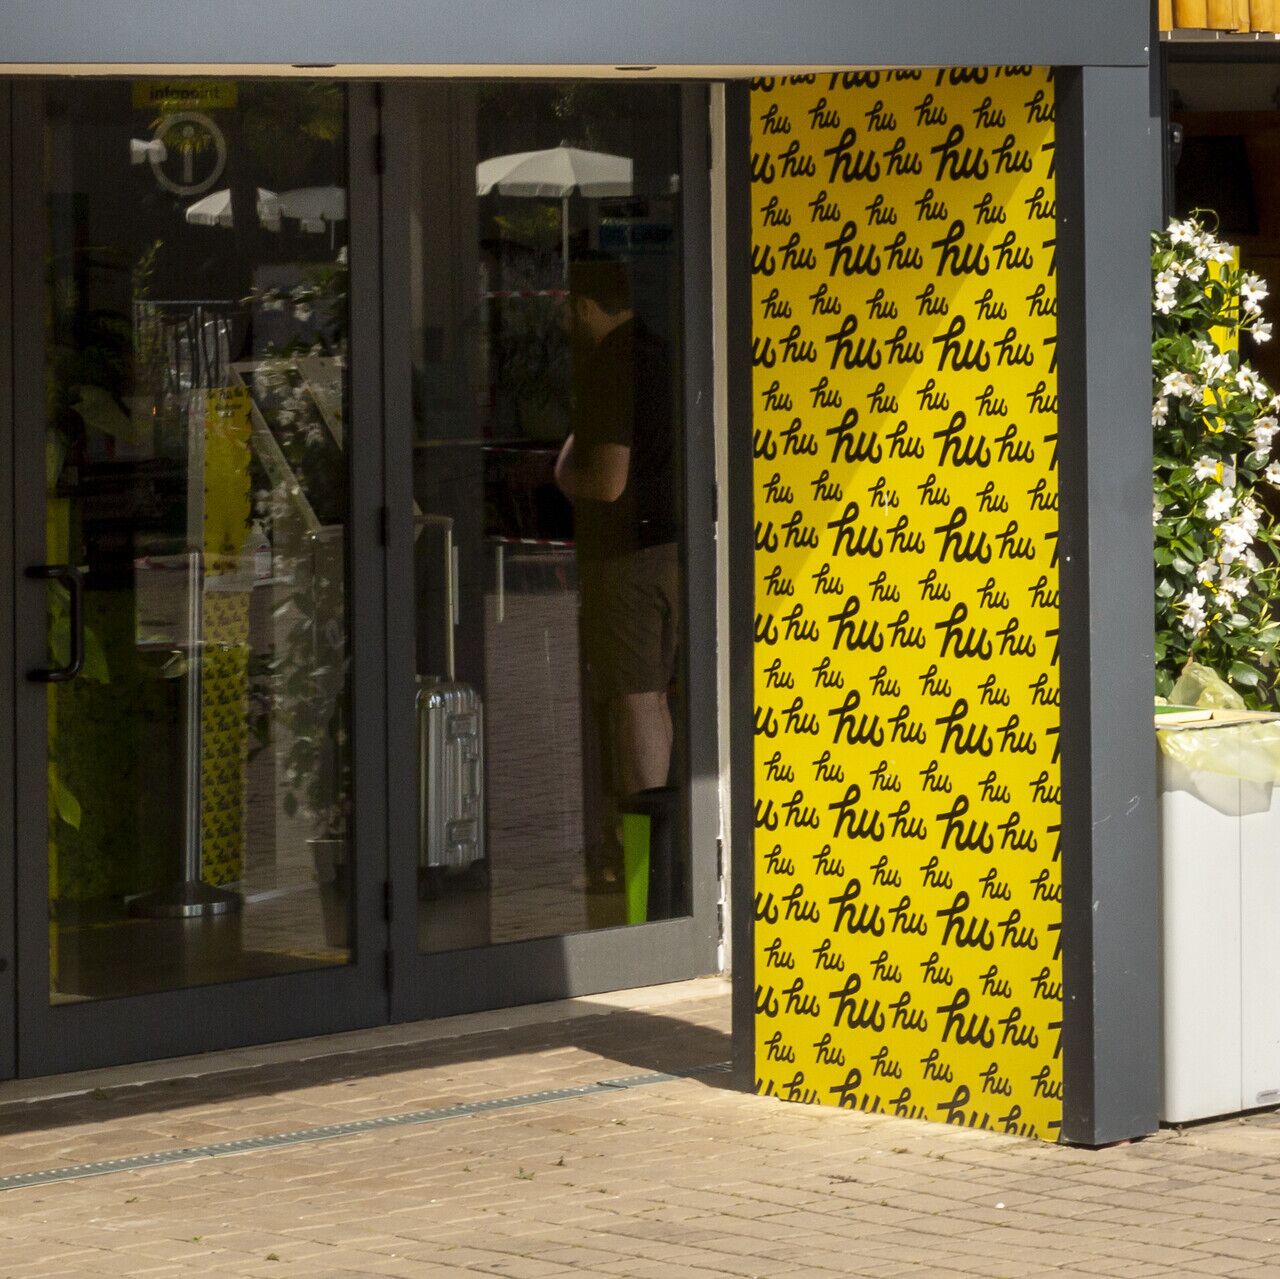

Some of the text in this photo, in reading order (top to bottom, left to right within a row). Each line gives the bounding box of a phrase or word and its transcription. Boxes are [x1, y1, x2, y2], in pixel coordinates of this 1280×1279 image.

[761, 104, 791, 134] hu
[809, 97, 840, 129] hu
[865, 101, 896, 131] hu
[915, 94, 947, 126] hu
[973, 97, 1005, 128] hu
[778, 124, 1032, 183] hu hu hu hu hu
[761, 196, 791, 226] hu
[809, 191, 840, 221] hu
[866, 194, 897, 225] hu
[915, 189, 947, 220] hu
[974, 193, 1006, 224] hu
[779, 220, 1033, 276] hu hu hu hu hu
[762, 288, 791, 318] hu
[809, 283, 841, 314] hu
[866, 288, 897, 319] hu
[916, 283, 948, 315] hu
[975, 289, 1006, 320] hu
[779, 314, 1033, 371] hu hu hu hu hu
[762, 381, 792, 411] hu
[810, 377, 841, 408] hu
[867, 383, 898, 413] hu
[917, 379, 949, 410] hu
[976, 385, 1007, 416] hu
[780, 408, 1034, 467] hu hu hu hu hu
[763, 473, 793, 503] hu
[811, 470, 842, 501] hu
[868, 477, 899, 508] hu
[918, 474, 949, 506] hu
[976, 481, 1008, 512] hu
[781, 502, 1035, 564] hu hu hu hu hu
[764, 565, 794, 596] hu
[812, 563, 843, 595] hu
[869, 571, 899, 602] hu
[919, 569, 950, 601] hu
[977, 578, 1009, 609] hu
[782, 596, 1035, 660] hu hu hu hu hu
[764, 659, 794, 689] hu
[813, 657, 843, 689] hu
[870, 666, 900, 697] hu
[919, 665, 951, 697] hu
[978, 674, 1009, 706] hu
[782, 690, 1036, 757] hu hu hu hu hu
[764, 752, 794, 782] hu
[813, 751, 844, 782] hu
[870, 761, 900, 792] hu
[920, 760, 951, 793] hu
[979, 771, 1010, 803] hu
[782, 784, 1037, 854] hu hu hu hu hu
[764, 845, 794, 875] hu
[813, 845, 844, 877] hu
[870, 855, 901, 887] hu
[920, 856, 952, 889] hu
[979, 868, 1011, 900] hu
[782, 879, 1037, 951] hu hu hu hu hu
[764, 938, 794, 969] hu
[813, 939, 844, 971] hu
[871, 951, 901, 983] hu
[921, 952, 952, 986] hu
[980, 965, 1011, 998] hu
[782, 973, 1038, 1048] hu hu hu hu hu
[765, 1031, 795, 1063] hu
[814, 1033, 844, 1066] hu
[871, 1046, 901, 1078] hu
[921, 1049, 952, 1082] hu
[980, 1063, 1011, 1096] hu
